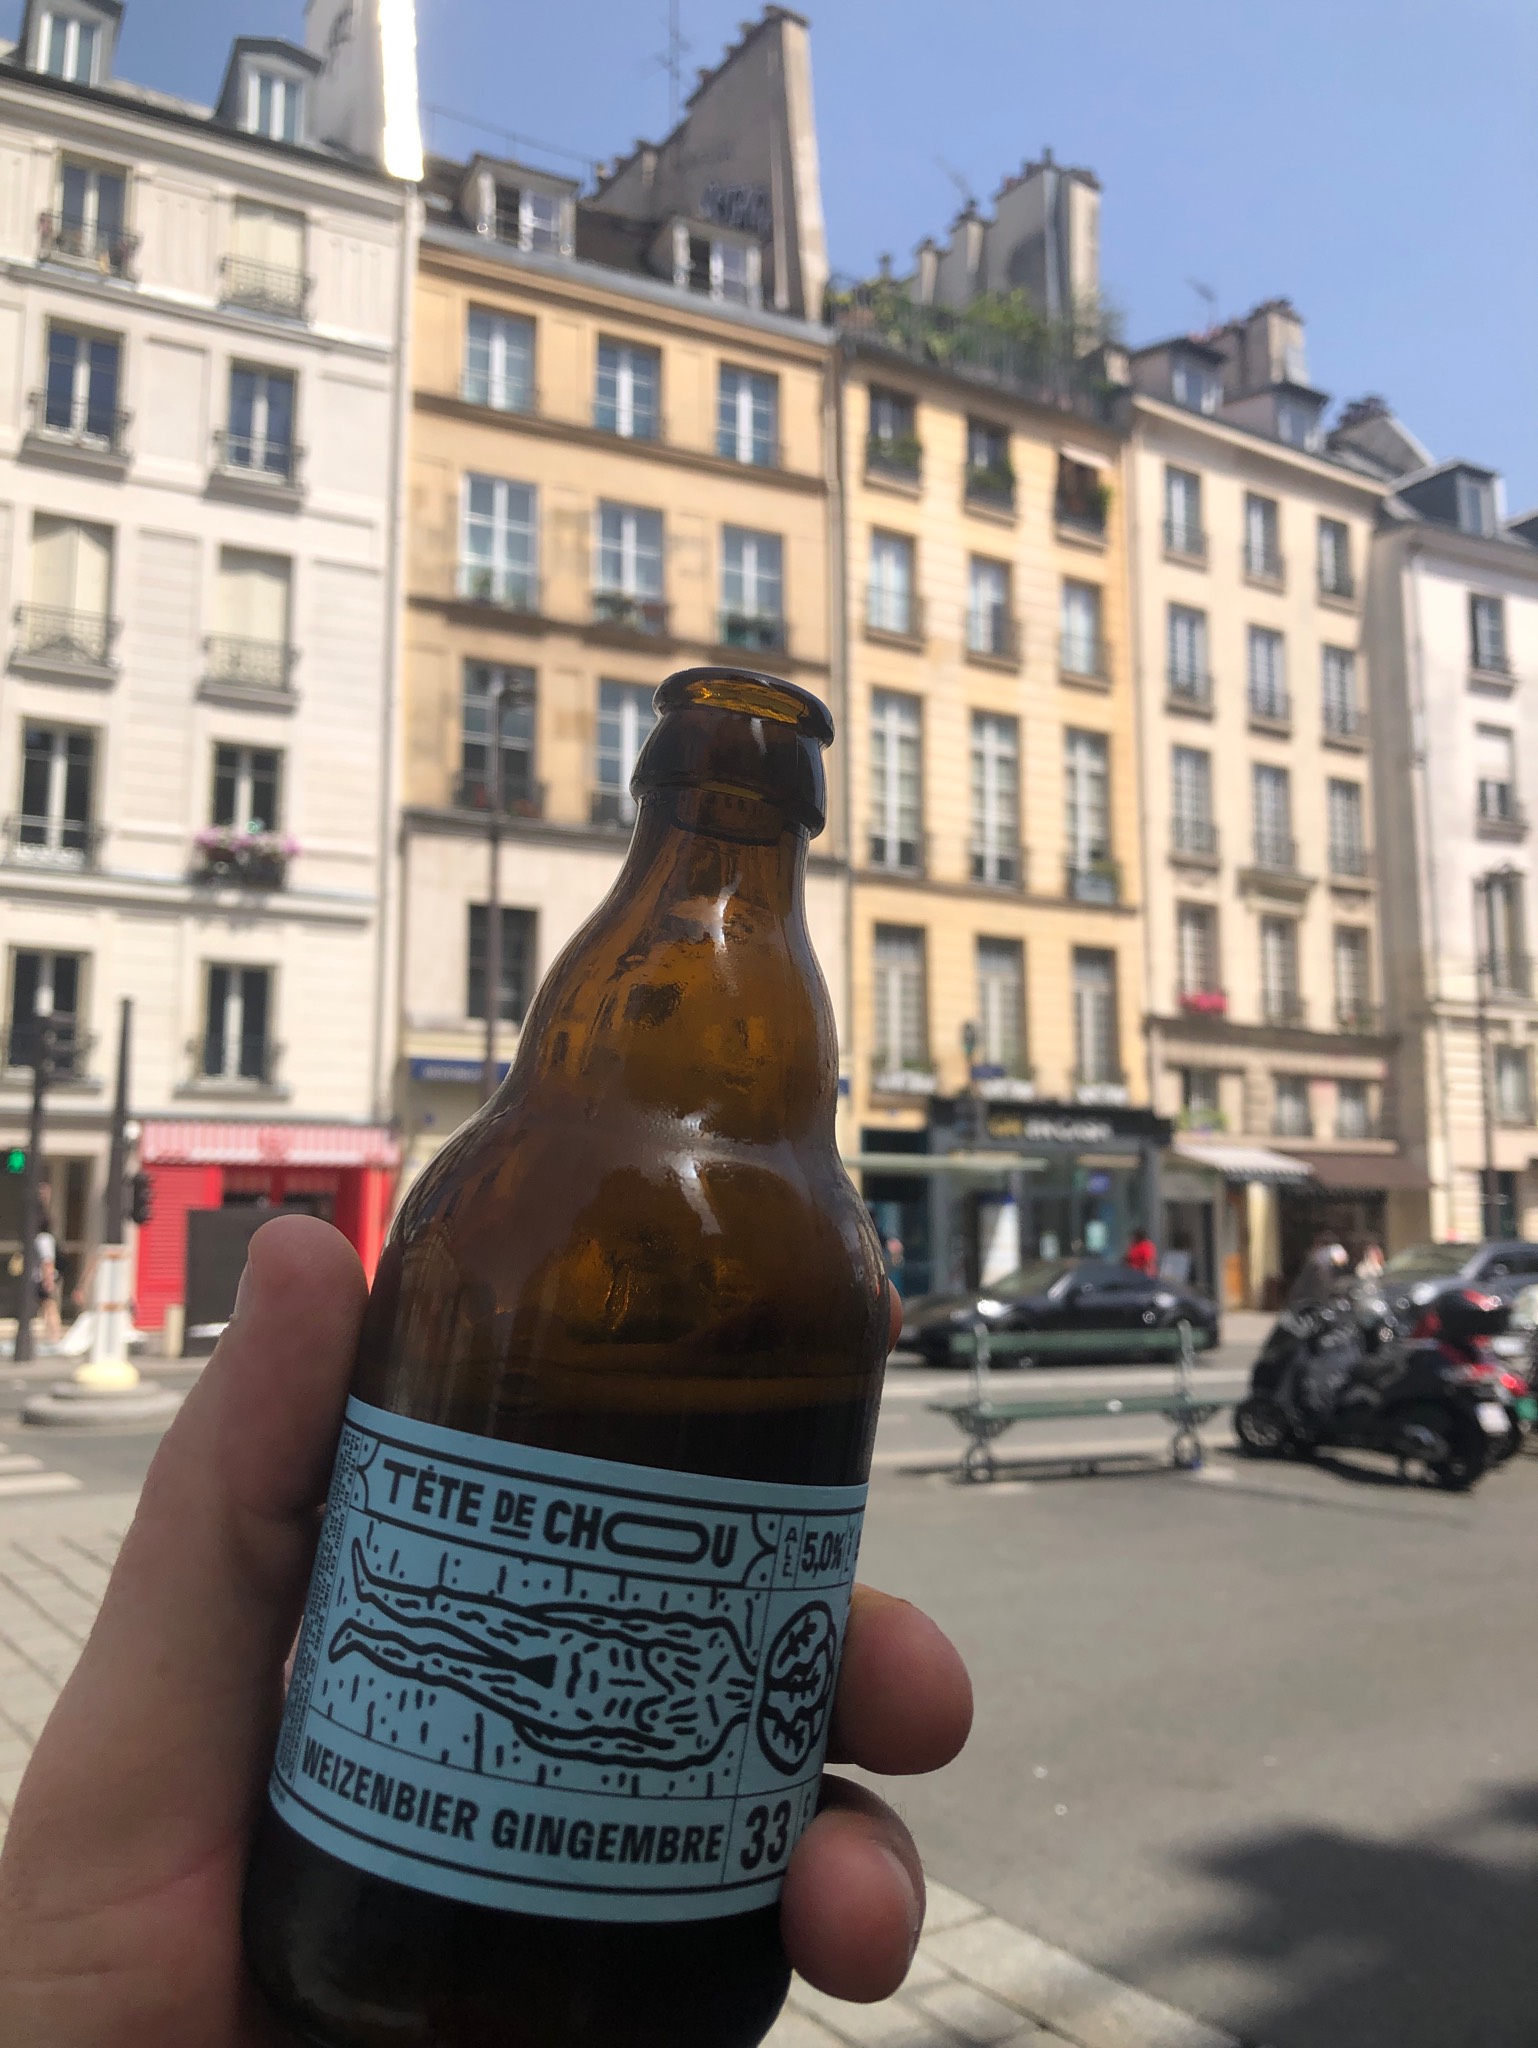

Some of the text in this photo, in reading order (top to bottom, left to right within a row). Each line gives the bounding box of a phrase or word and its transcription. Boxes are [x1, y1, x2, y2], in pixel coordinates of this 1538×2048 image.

[492, 1488, 538, 1530] DE
[543, 1499, 738, 1568] CHOU
[801, 1531, 845, 1579] 5,0%
[302, 1735, 725, 1865] WEIZENBIER GINGEMBRE
[740, 1800, 791, 1870] 33
